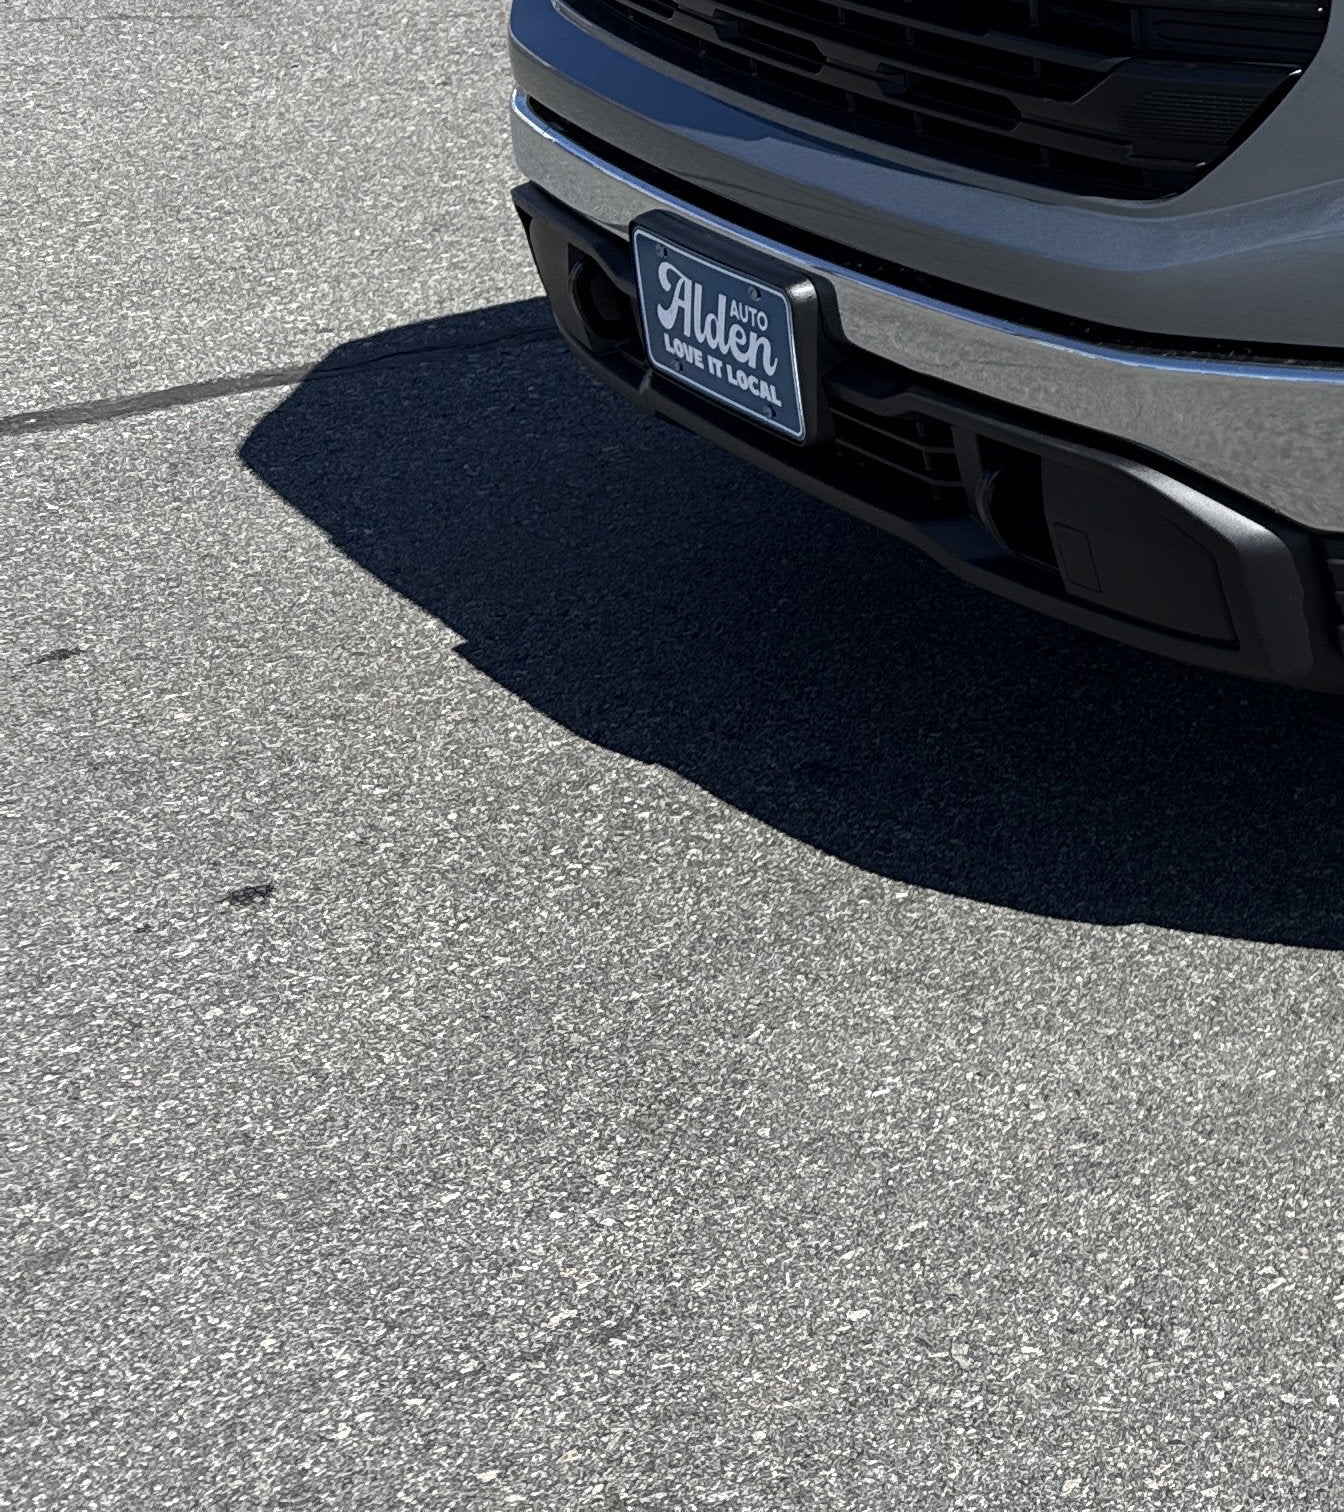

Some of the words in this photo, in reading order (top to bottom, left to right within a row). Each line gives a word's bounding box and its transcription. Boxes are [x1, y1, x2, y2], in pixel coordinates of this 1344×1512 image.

[657, 261, 779, 377] Alden
[729, 299, 769, 332] AUTO
[663, 333, 705, 370] LOVE
[707, 354, 723, 379] IT
[726, 363, 783, 408] LOCAL
